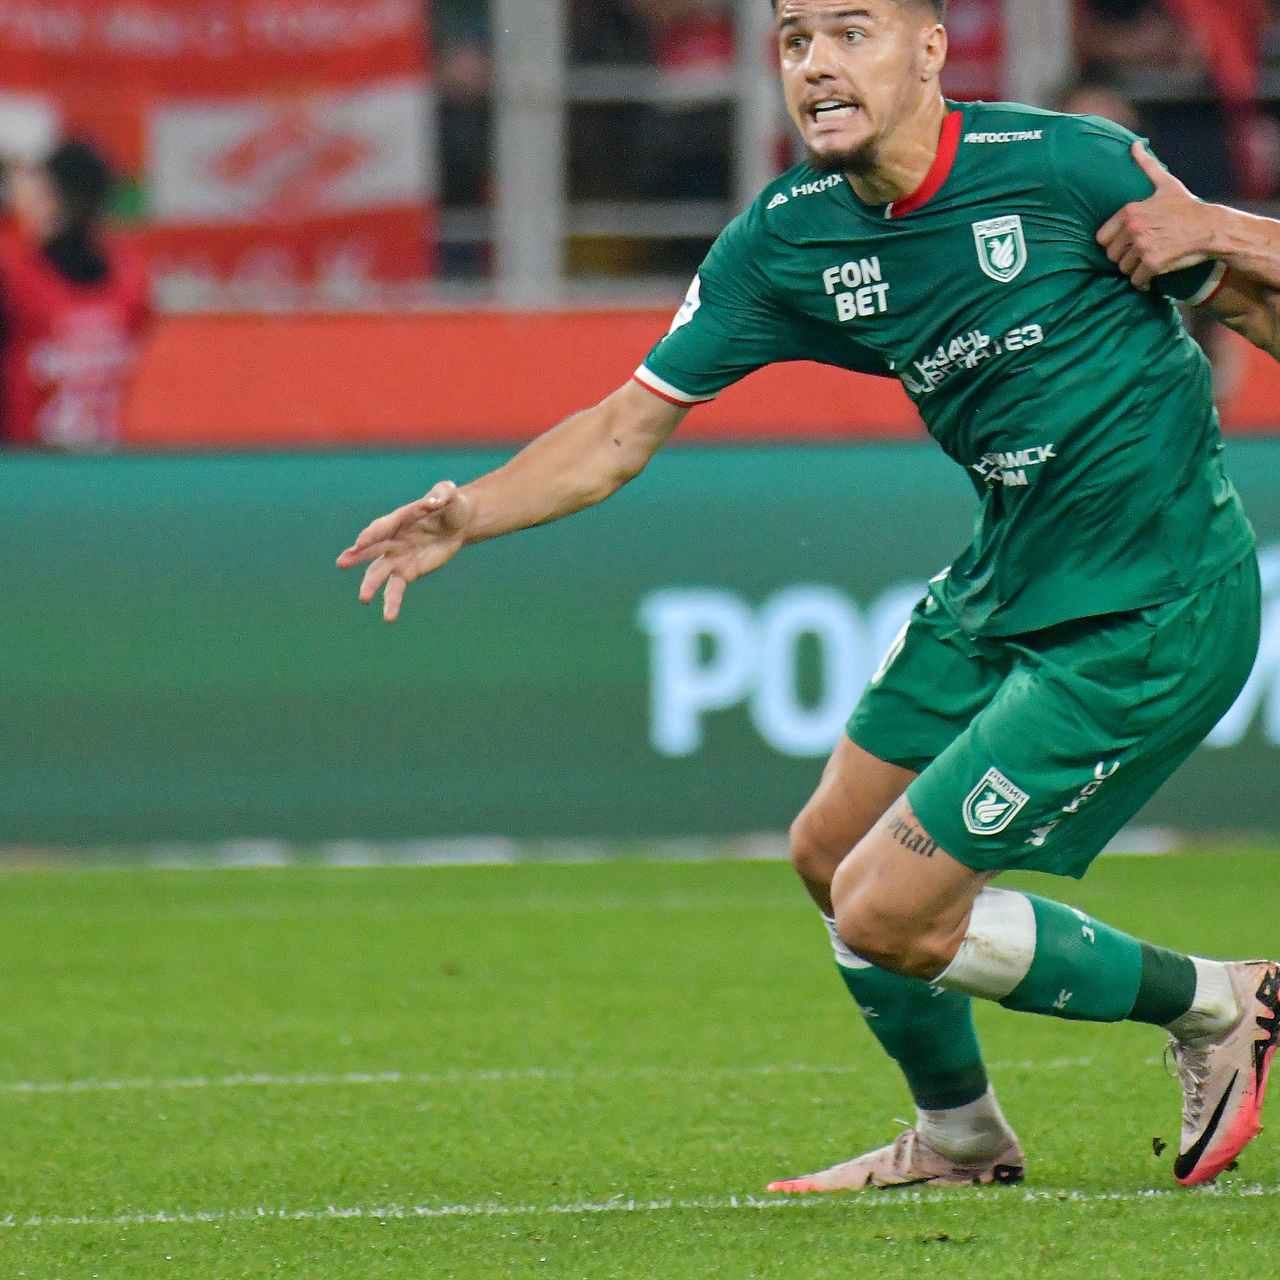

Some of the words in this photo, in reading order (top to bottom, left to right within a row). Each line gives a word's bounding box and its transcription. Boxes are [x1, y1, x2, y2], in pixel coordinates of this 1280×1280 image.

[963, 130, 1043, 143] ИНГОССТРАХ
[822, 256, 882, 295] FON
[835, 282, 890, 322] BET
